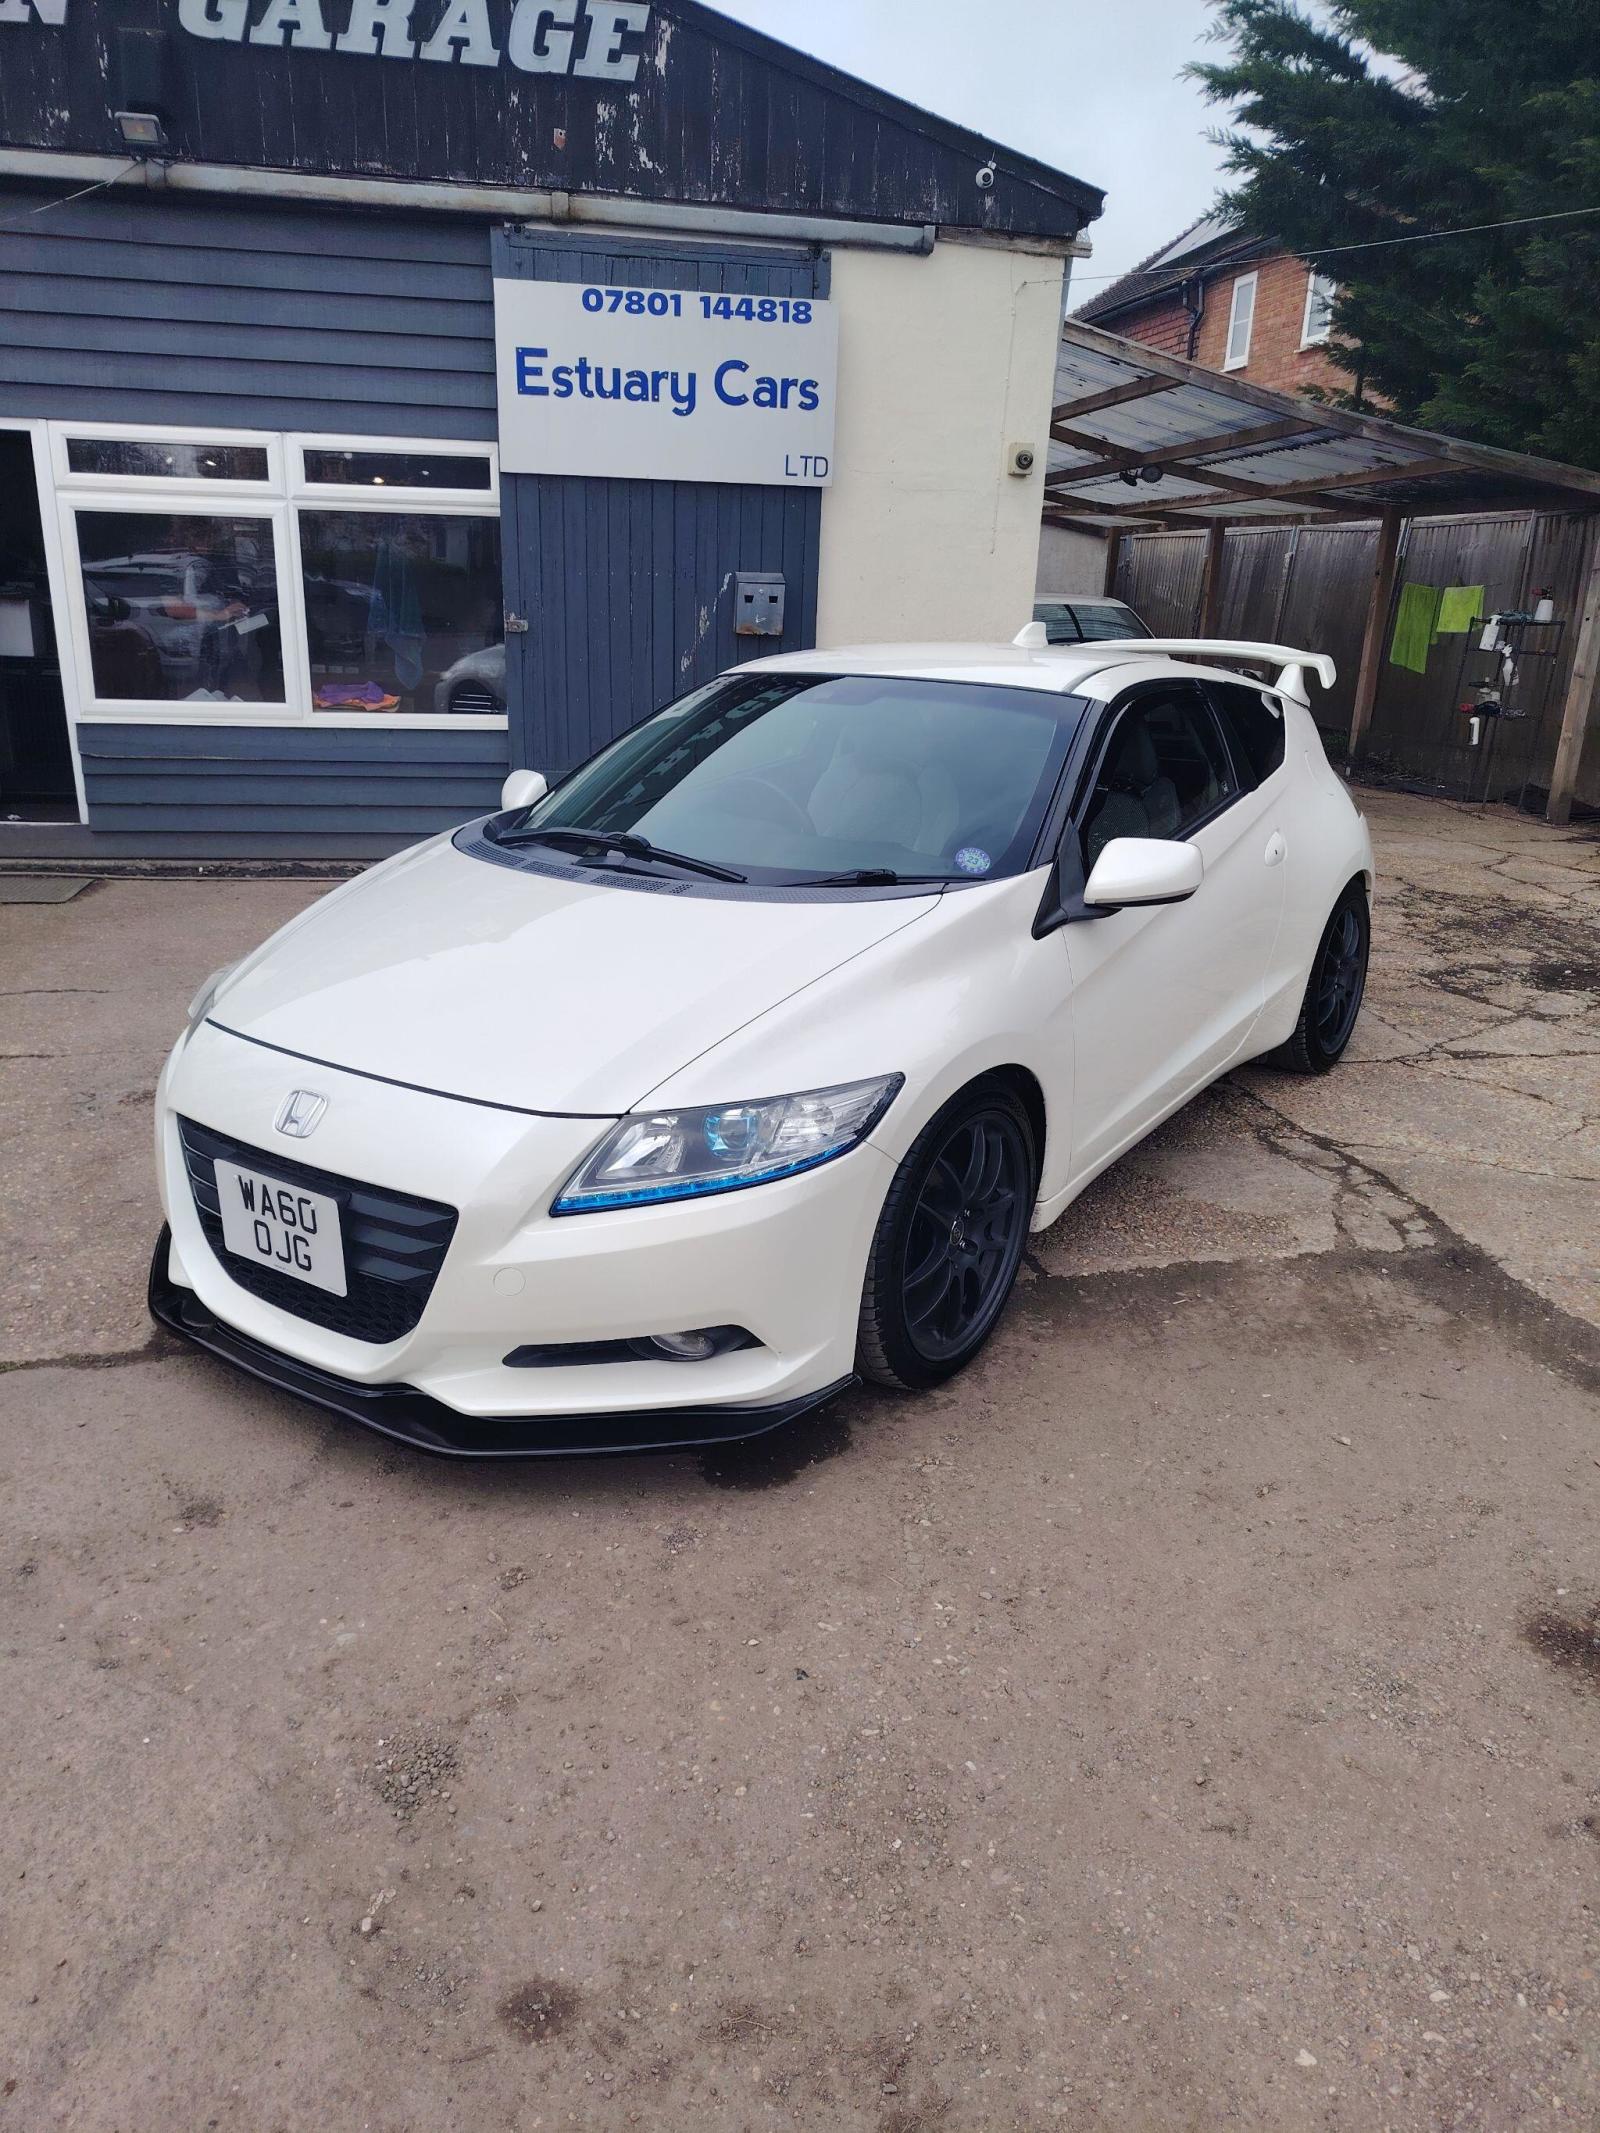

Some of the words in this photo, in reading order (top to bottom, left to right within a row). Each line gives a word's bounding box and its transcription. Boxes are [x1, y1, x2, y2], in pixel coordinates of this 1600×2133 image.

[582, 288, 682, 317] 07801
[699, 296, 813, 324] 144818
[515, 346, 697, 416] Estuary
[713, 359, 820, 411] Cars
[785, 455, 828, 477] LTD
[238, 1175, 317, 1235] WA60
[254, 1219, 312, 1272] OJG
